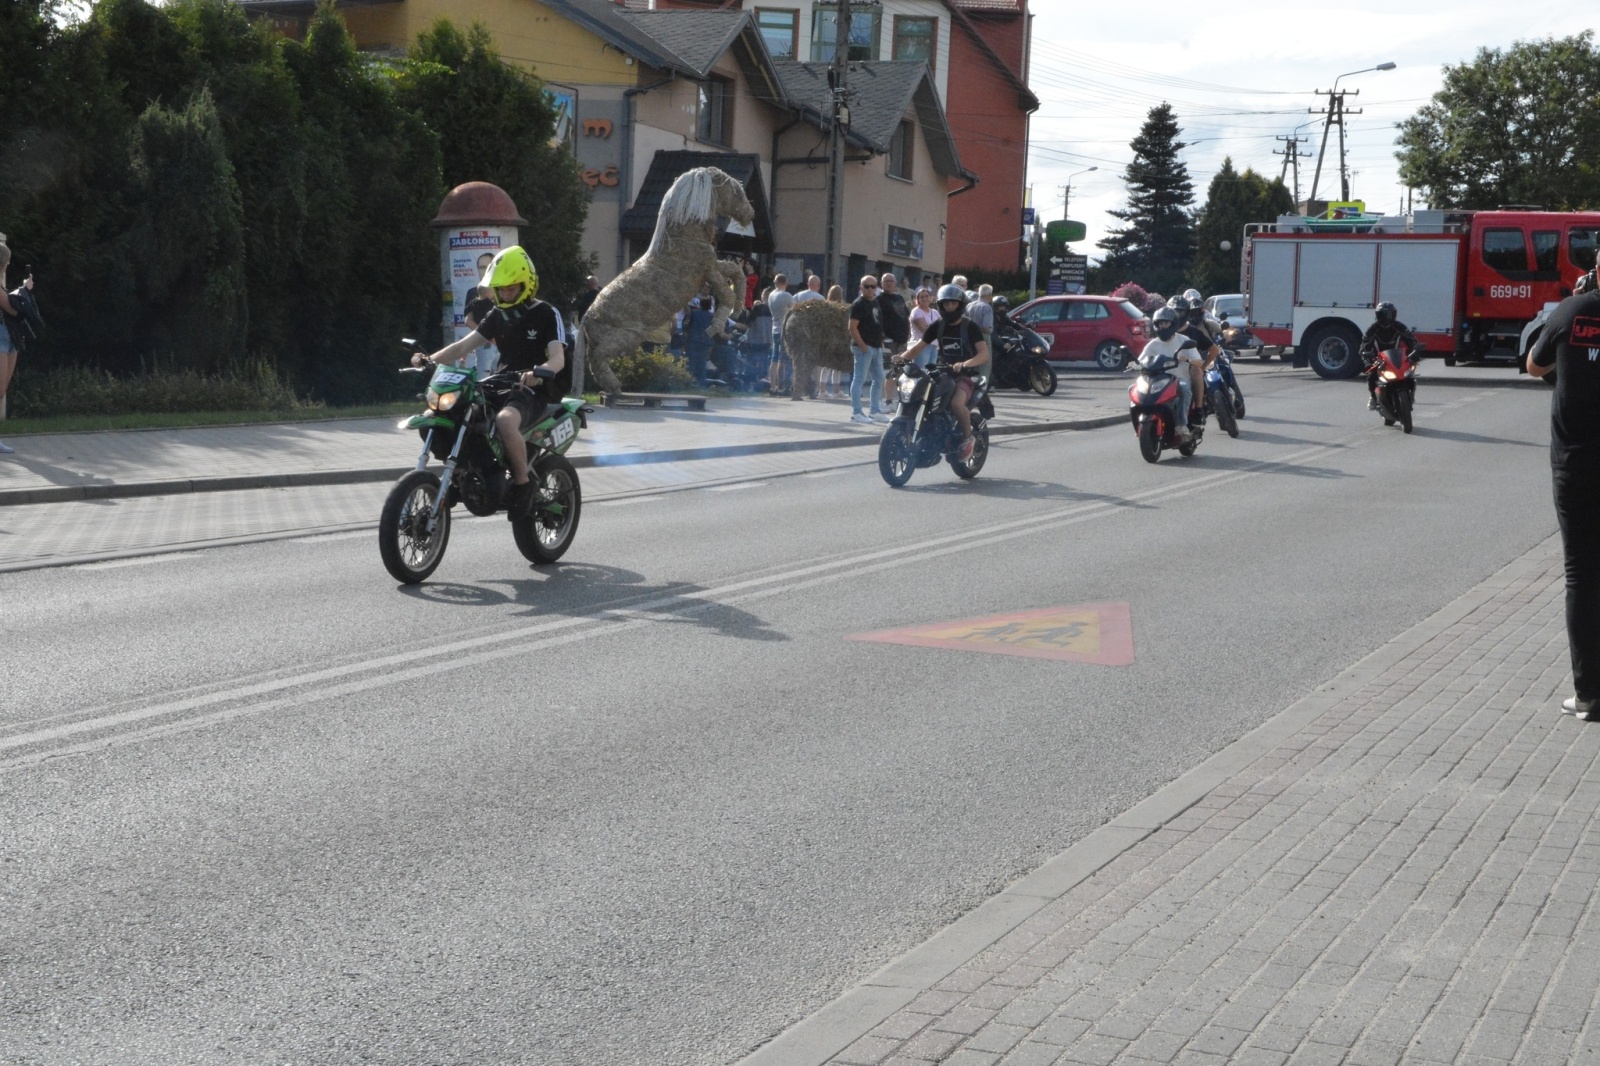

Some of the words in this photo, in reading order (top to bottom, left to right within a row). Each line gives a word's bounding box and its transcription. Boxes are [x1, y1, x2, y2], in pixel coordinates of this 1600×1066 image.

[452, 236, 498, 246] JABŁOŃSKI
[435, 372, 466, 384] 169
[551, 418, 574, 447] 169
